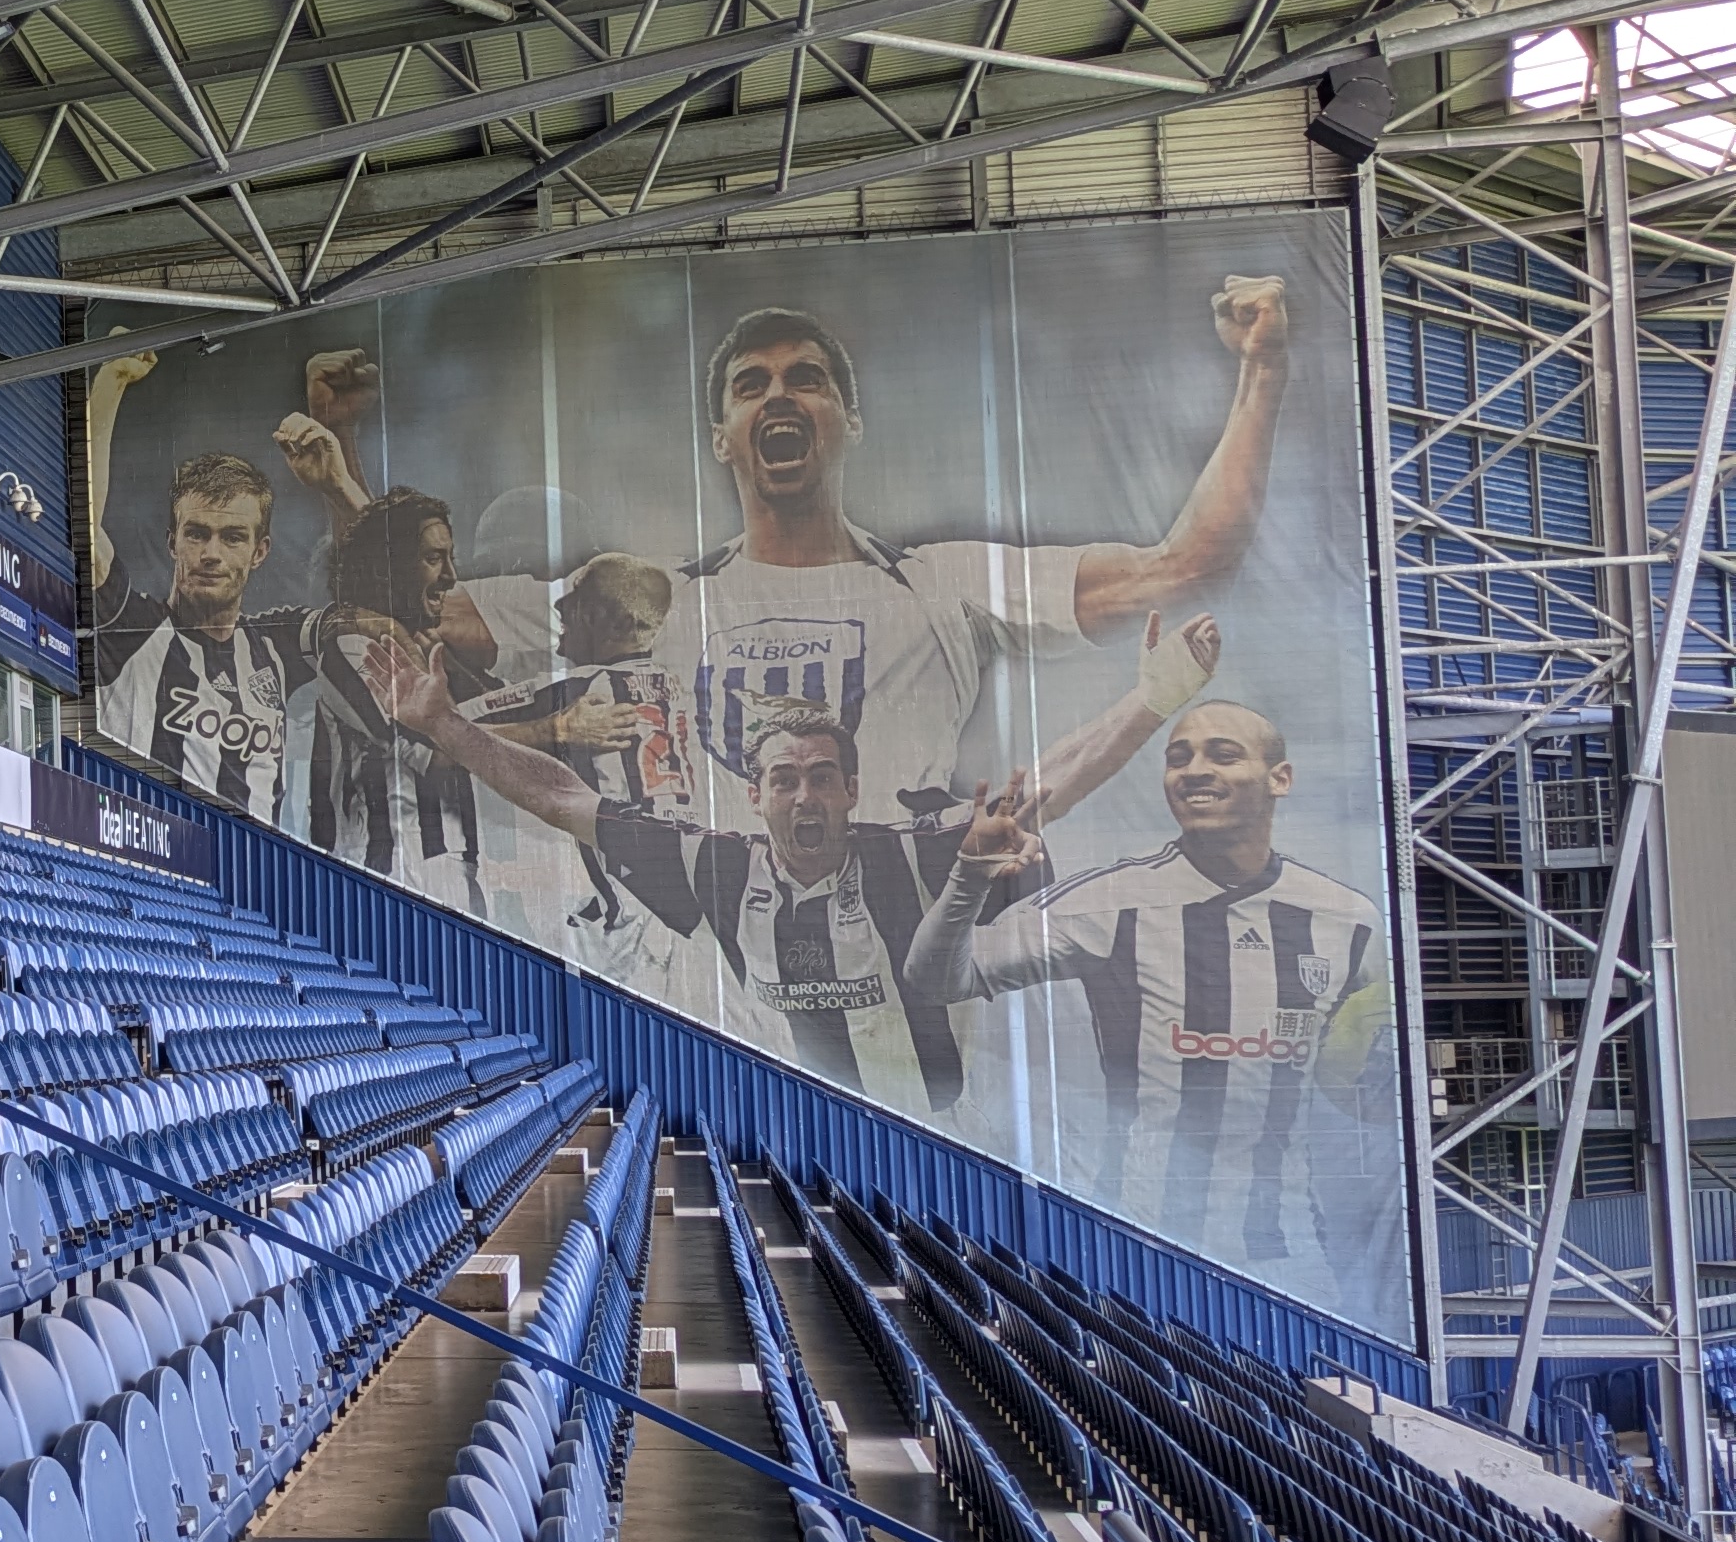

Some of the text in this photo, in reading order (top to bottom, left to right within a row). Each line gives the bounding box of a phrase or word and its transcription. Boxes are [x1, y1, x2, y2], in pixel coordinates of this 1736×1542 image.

[727, 638, 833, 661] ALBION
[98, 792, 171, 859] ideal HEATING
[788, 976, 880, 997] BROMWICH
[817, 990, 882, 1010] SOCIETY
[1172, 1023, 1311, 1067] bodog
